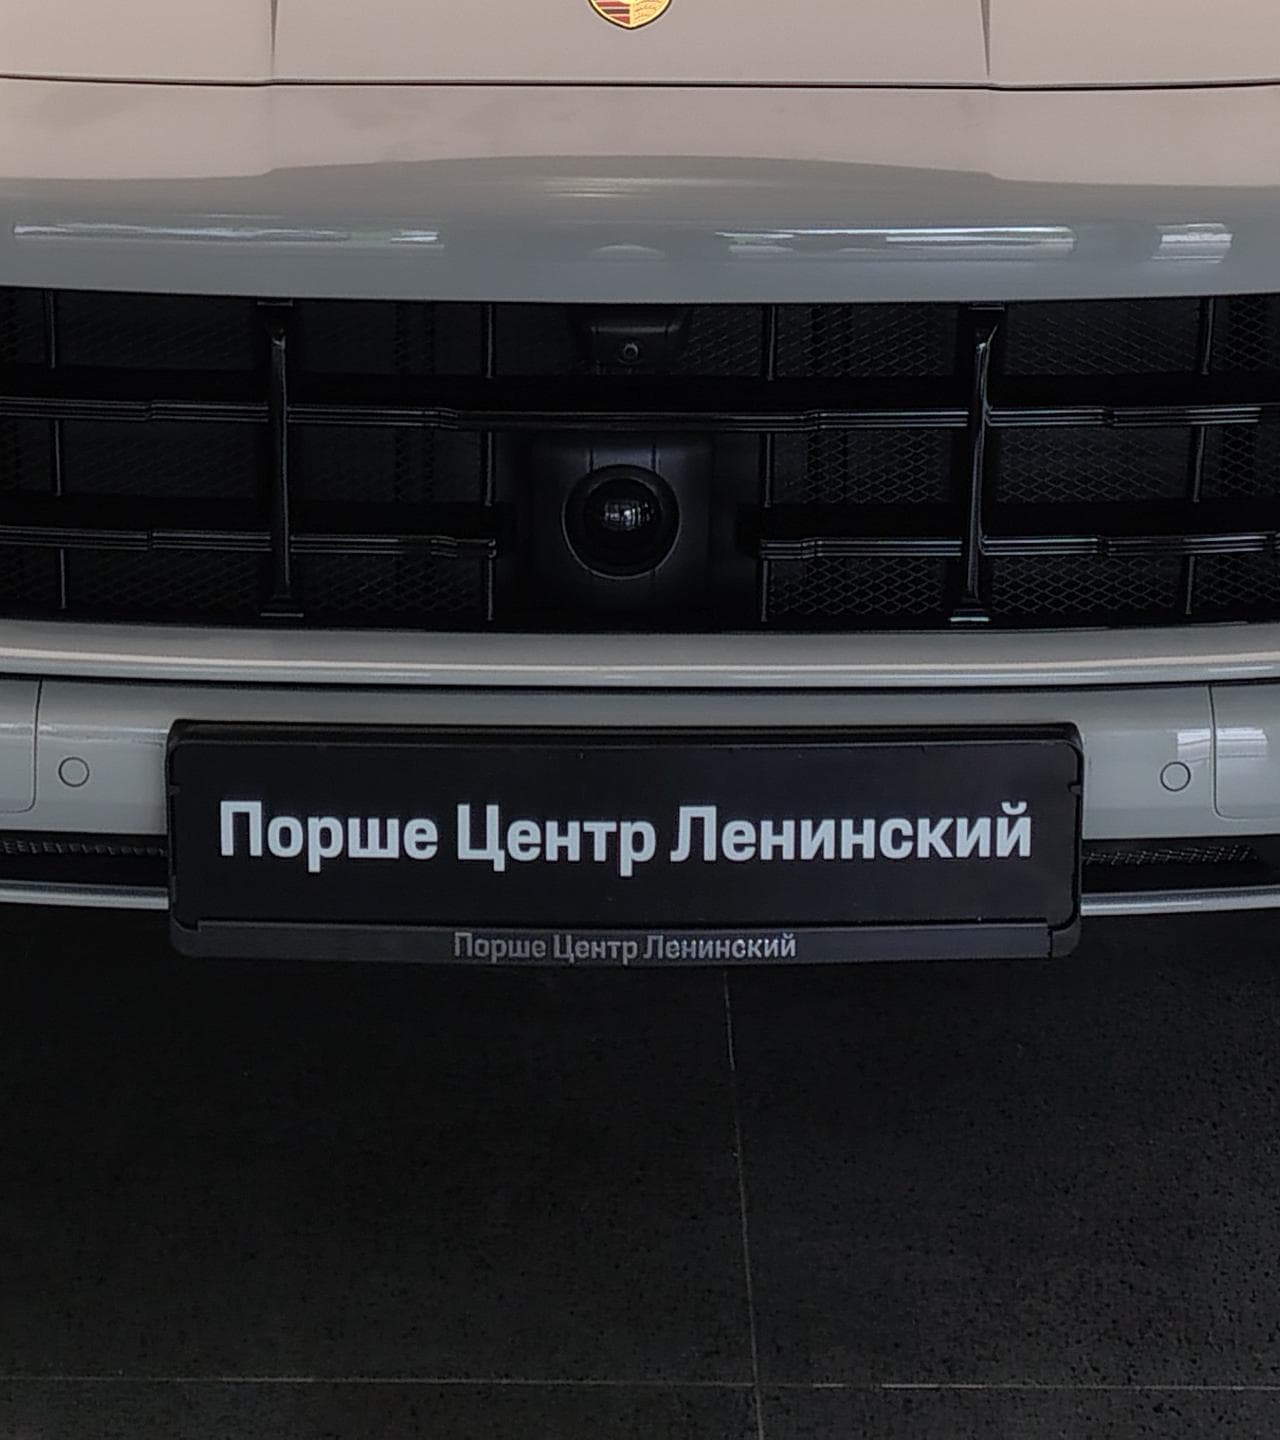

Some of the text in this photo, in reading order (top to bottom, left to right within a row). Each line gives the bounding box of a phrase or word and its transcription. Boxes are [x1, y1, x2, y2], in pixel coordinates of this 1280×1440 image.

[219, 800, 1032, 878] Порше Центр Ленинский
[453, 931, 797, 966] Порше Центр Ленинский
